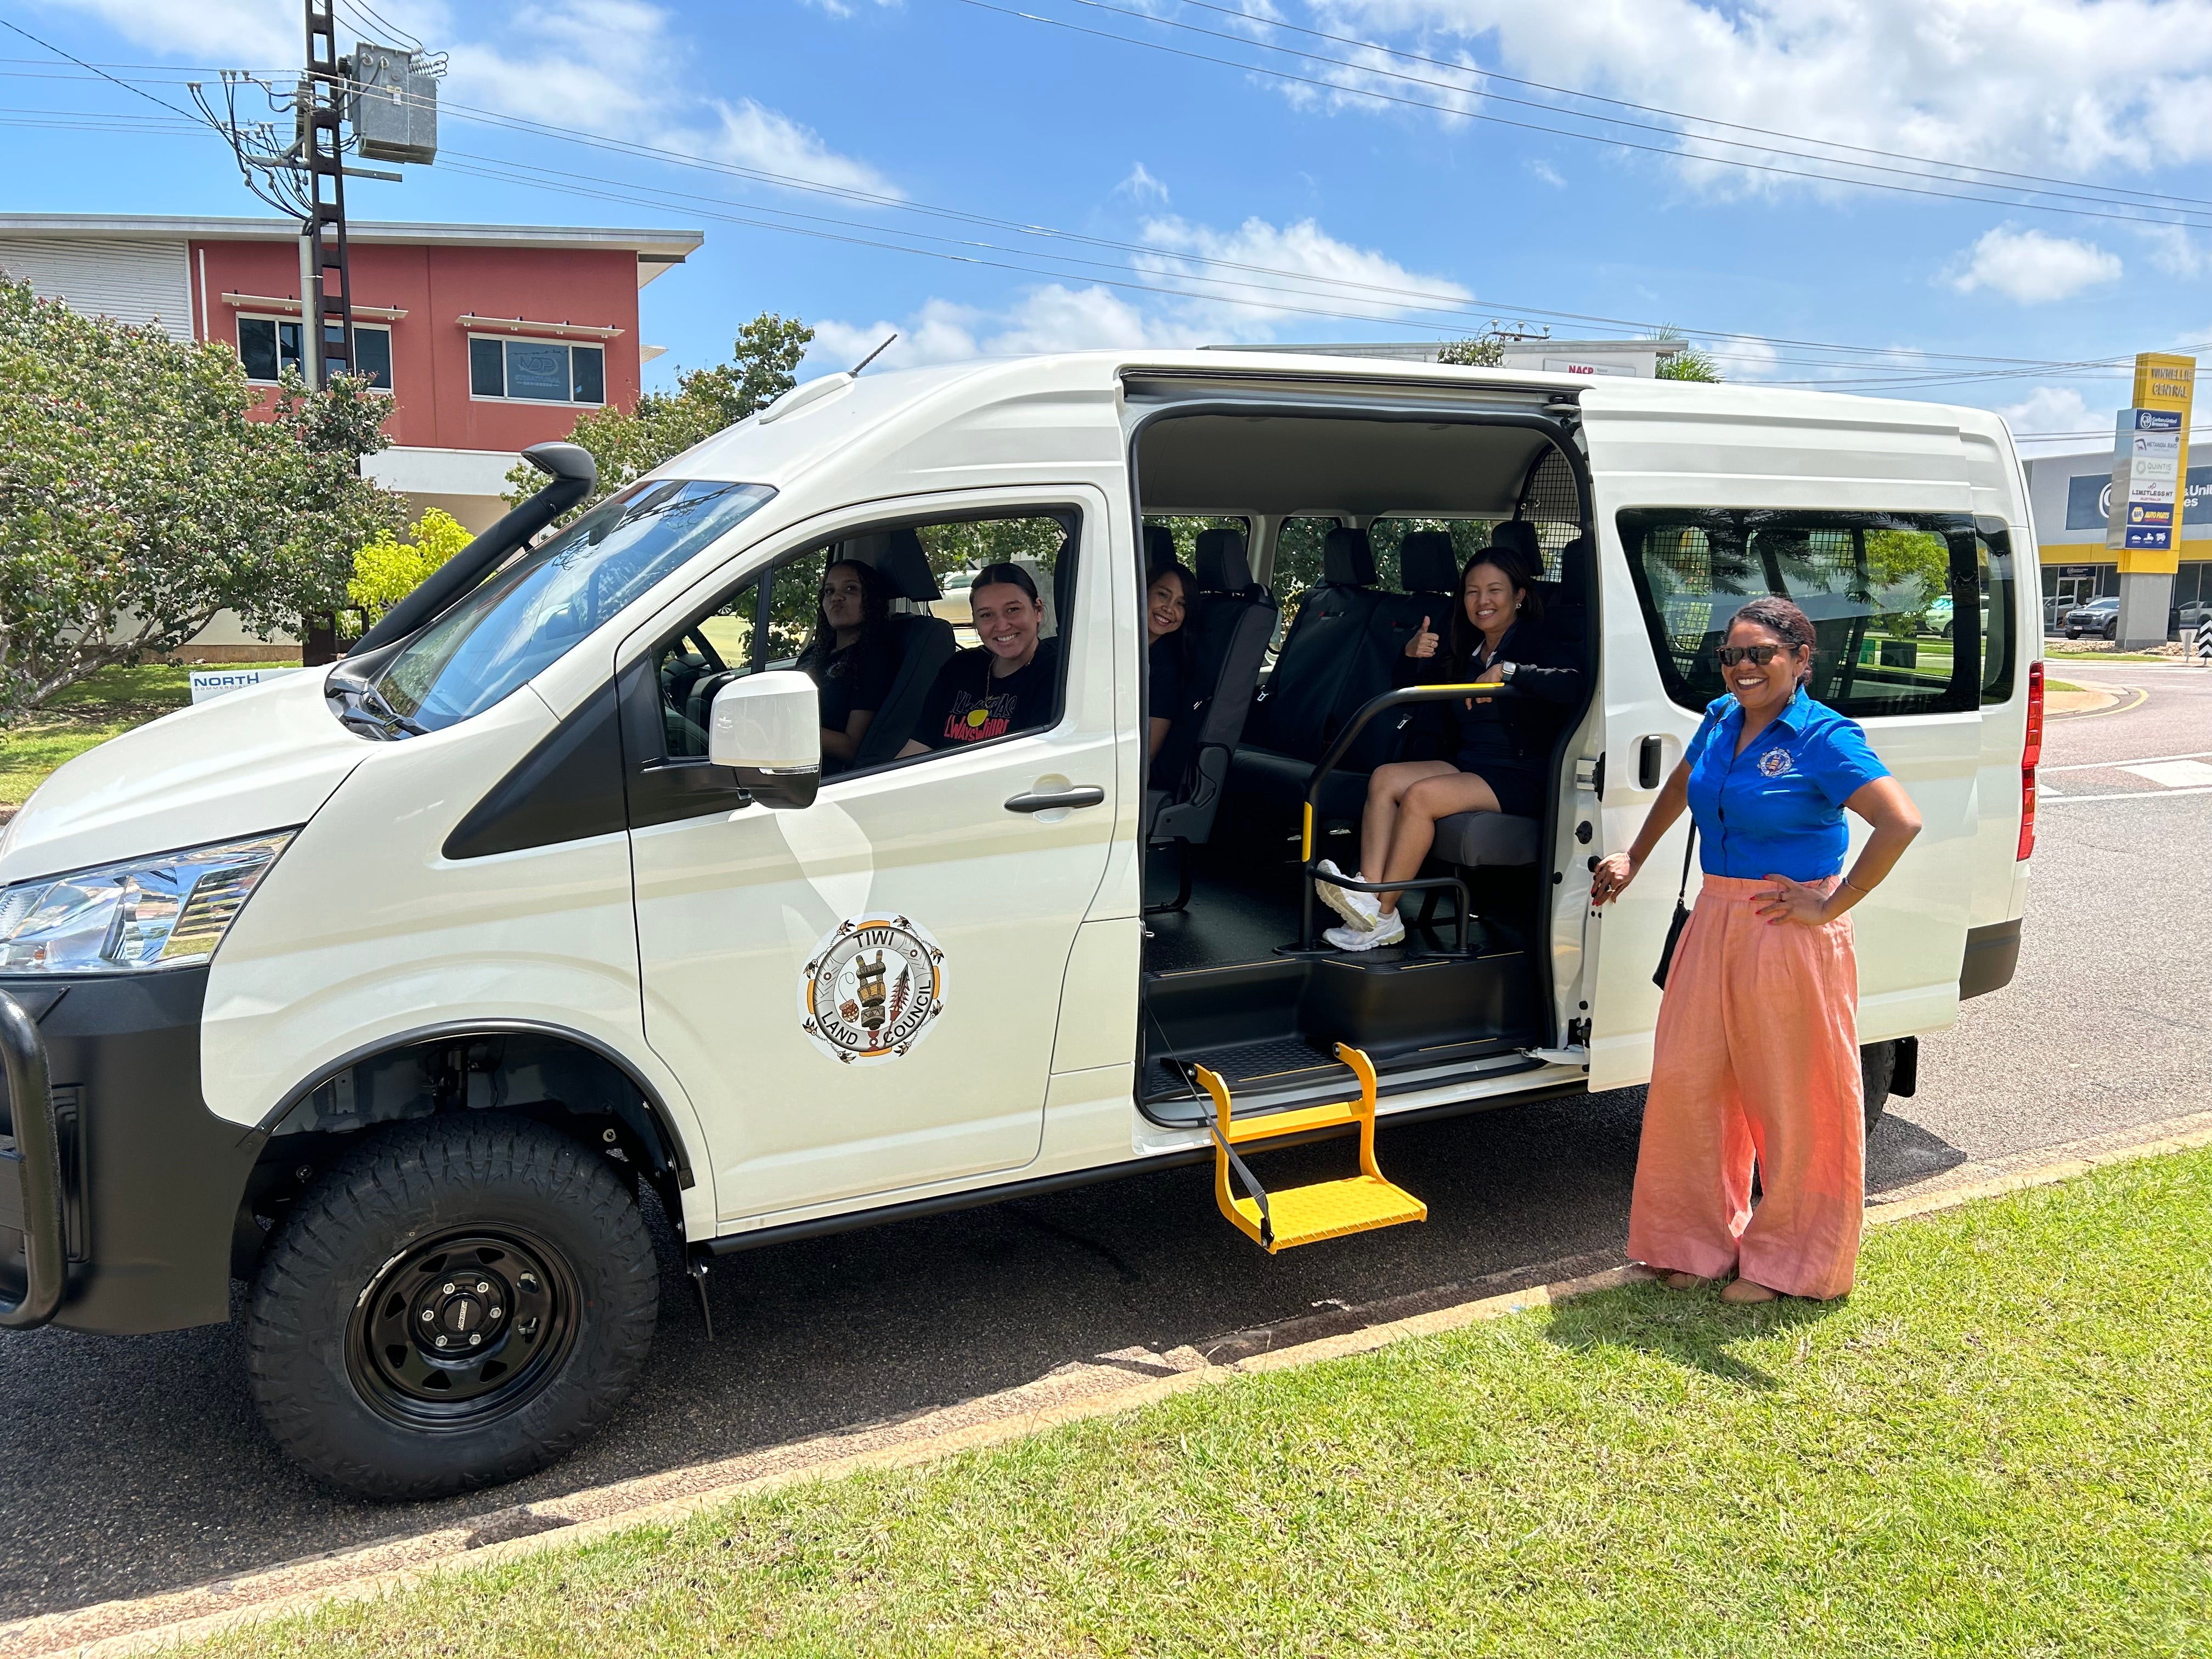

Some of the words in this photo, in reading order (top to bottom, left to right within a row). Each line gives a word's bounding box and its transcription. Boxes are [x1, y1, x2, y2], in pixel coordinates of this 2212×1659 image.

[2152, 368, 2192, 381] WINNELLIE
[2153, 383, 2188, 398] CENTRAL
[2147, 462, 2171, 471] QUINTIS
[194, 672, 259, 686] NORTH
[853, 930, 894, 948] TIWI
[821, 1011, 858, 1045] LAND
[883, 979, 931, 1043] COUNCIL
